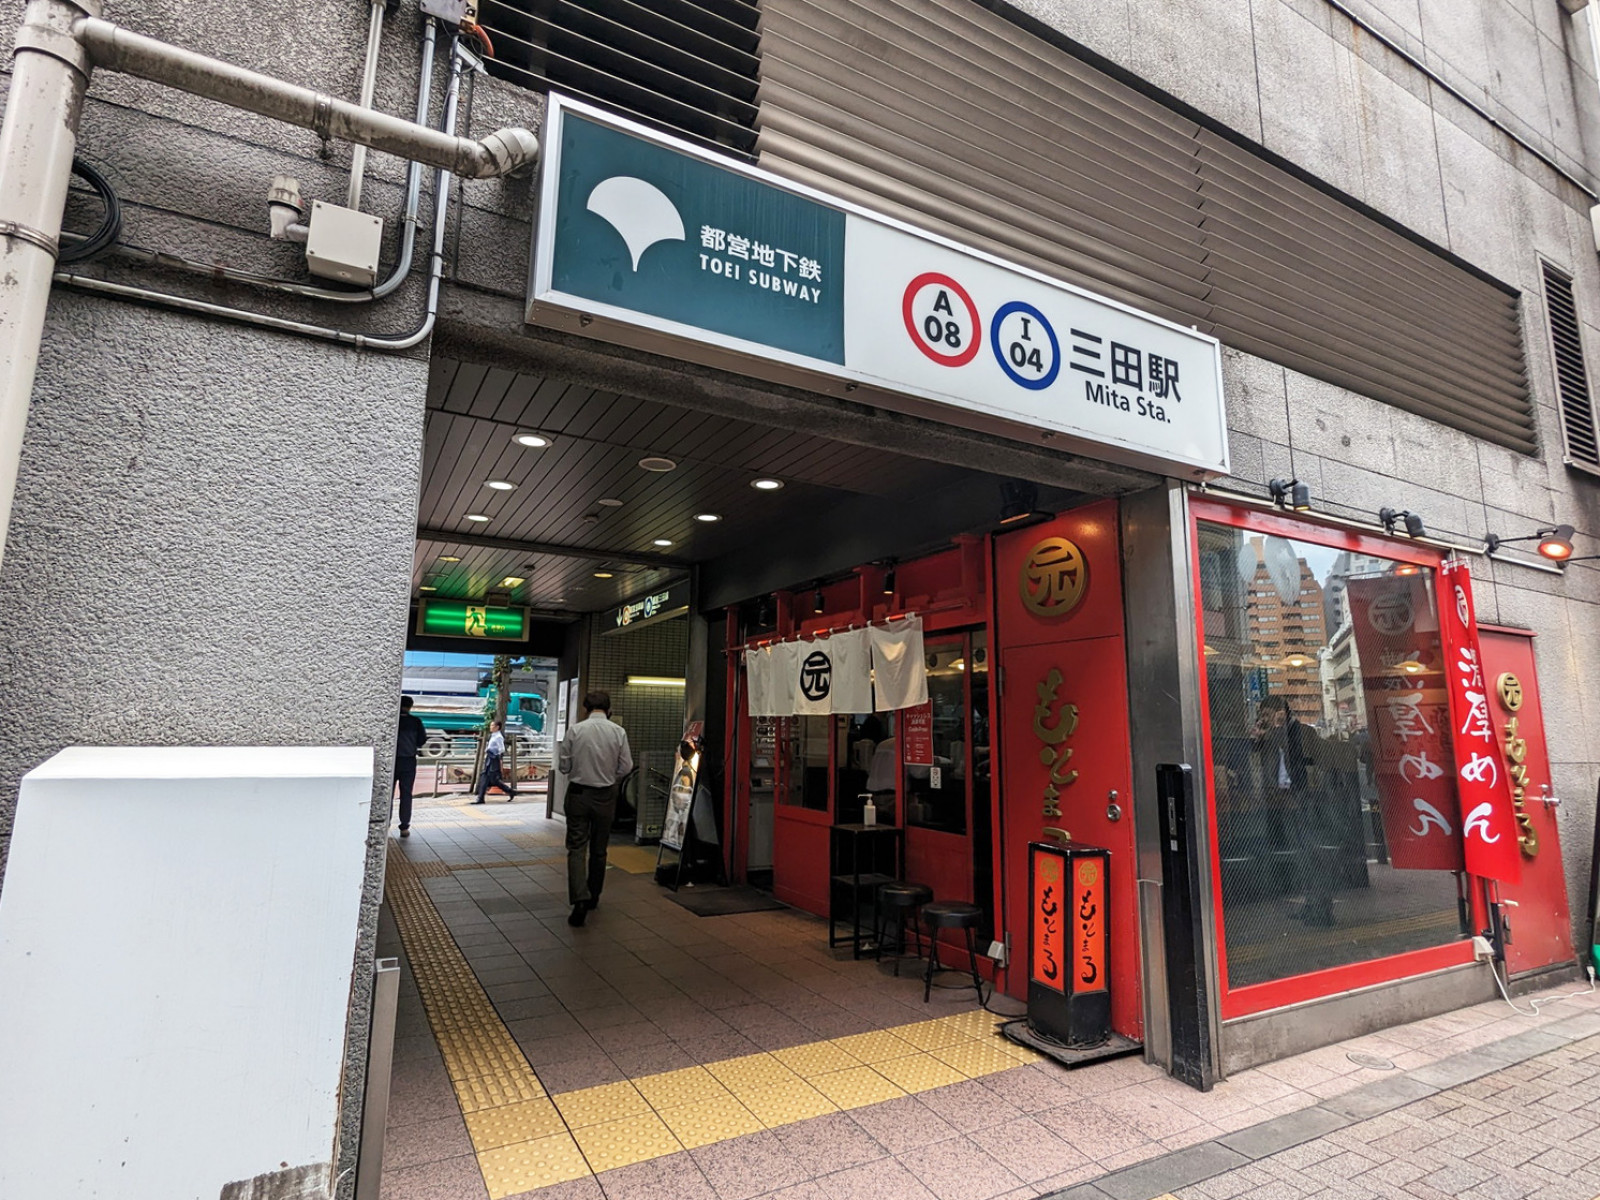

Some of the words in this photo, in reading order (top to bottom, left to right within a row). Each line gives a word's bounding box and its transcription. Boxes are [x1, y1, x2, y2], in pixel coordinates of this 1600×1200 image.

[700, 225, 822, 283] 都営地下鉄
[699, 254, 740, 281] TOEI
[748, 269, 822, 304] SUBWAY
[932, 290, 954, 317] A
[924, 315, 962, 349] 08
[1020, 316, 1032, 342] I
[1009, 341, 1044, 373] 04
[1069, 327, 1182, 403] 三田駅
[1085, 380, 1131, 413] Mita
[1136, 396, 1172, 424] Sta.
[802, 658, 831, 694] 元
